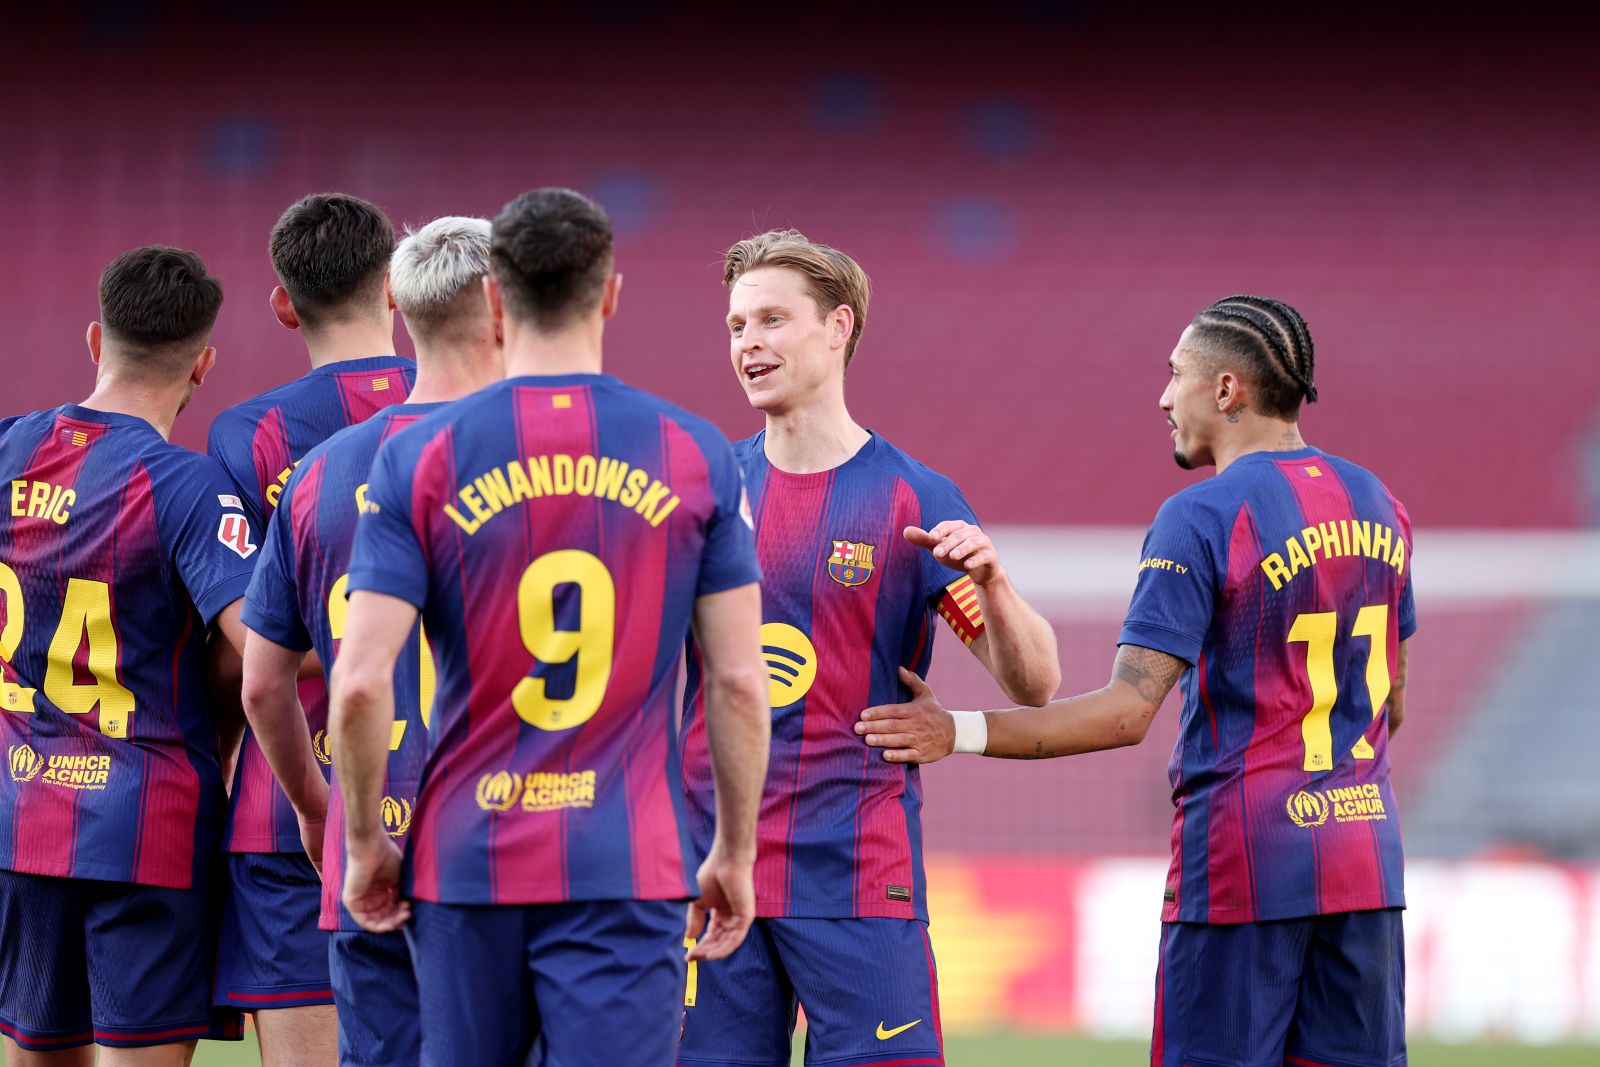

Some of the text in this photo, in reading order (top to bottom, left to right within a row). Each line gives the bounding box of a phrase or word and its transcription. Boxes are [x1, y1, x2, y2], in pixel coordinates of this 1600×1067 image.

[11, 480, 77, 525] ERIC
[443, 454, 681, 536] LEWANDOWSKI
[1260, 519, 1406, 592] RAPHINHA
[1175, 563, 1188, 574] tv
[511, 548, 616, 732] 9
[1287, 604, 1391, 772] 11
[48, 755, 111, 770] UNHCR
[42, 768, 109, 784] ACNUR
[525, 769, 597, 789] UNHCR
[521, 785, 595, 806] ACNUR
[1325, 784, 1380, 802] UNHCR
[1334, 799, 1384, 816] ACNUR
